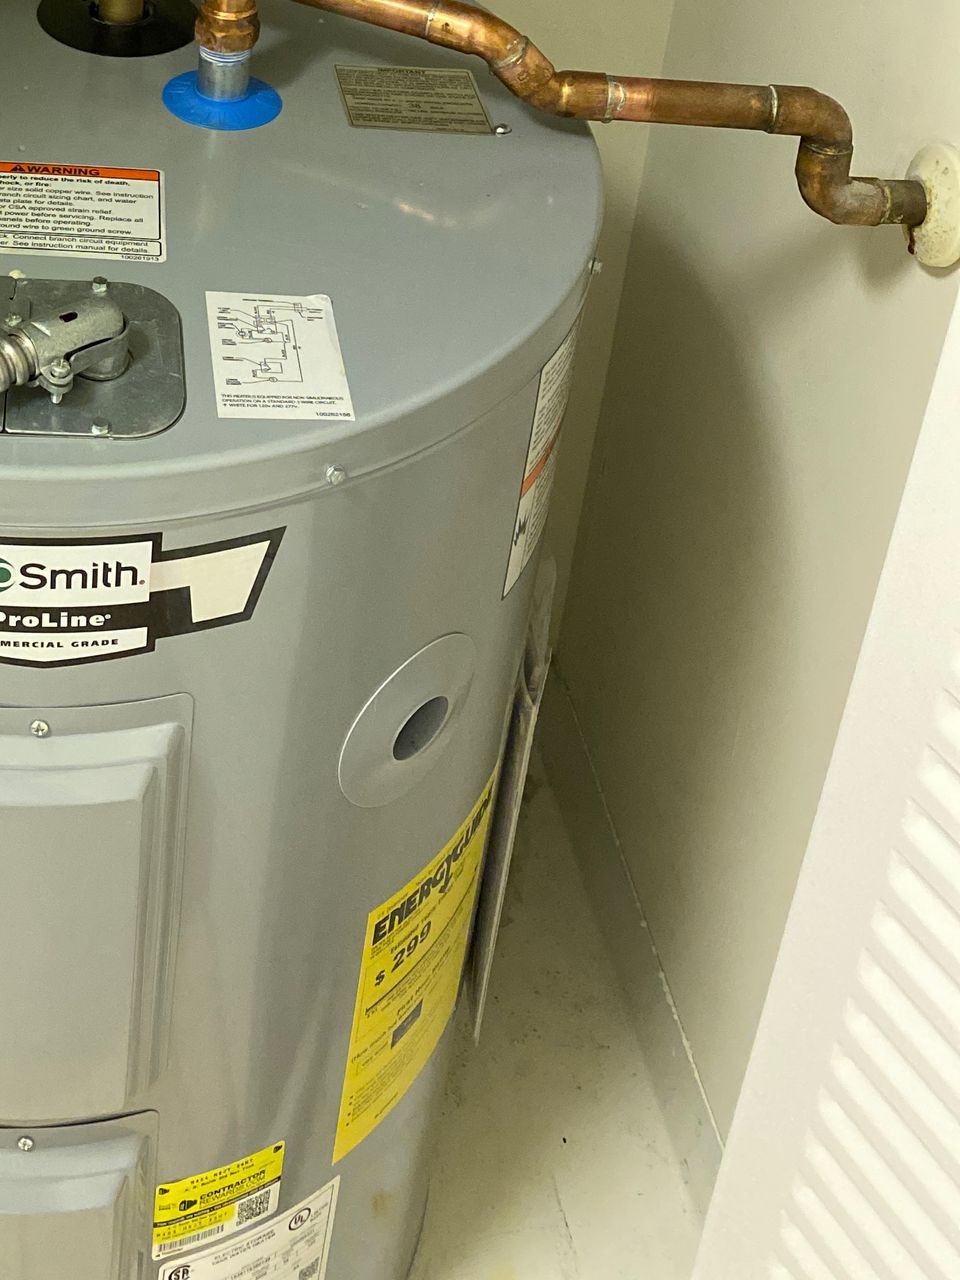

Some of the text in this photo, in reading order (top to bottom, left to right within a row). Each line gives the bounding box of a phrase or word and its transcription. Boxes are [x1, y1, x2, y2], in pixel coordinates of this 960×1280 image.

[27, 165, 100, 176] WARNING
[113, 191, 154, 199] instruction
[98, 215, 132, 223] Replace
[105, 239, 148, 247] equipment
[71, 638, 119, 648] GRADE
[374, 970, 385, 987] $
[391, 921, 431, 973] 299
[200, 1169, 266, 1200] CONTRACTOR
